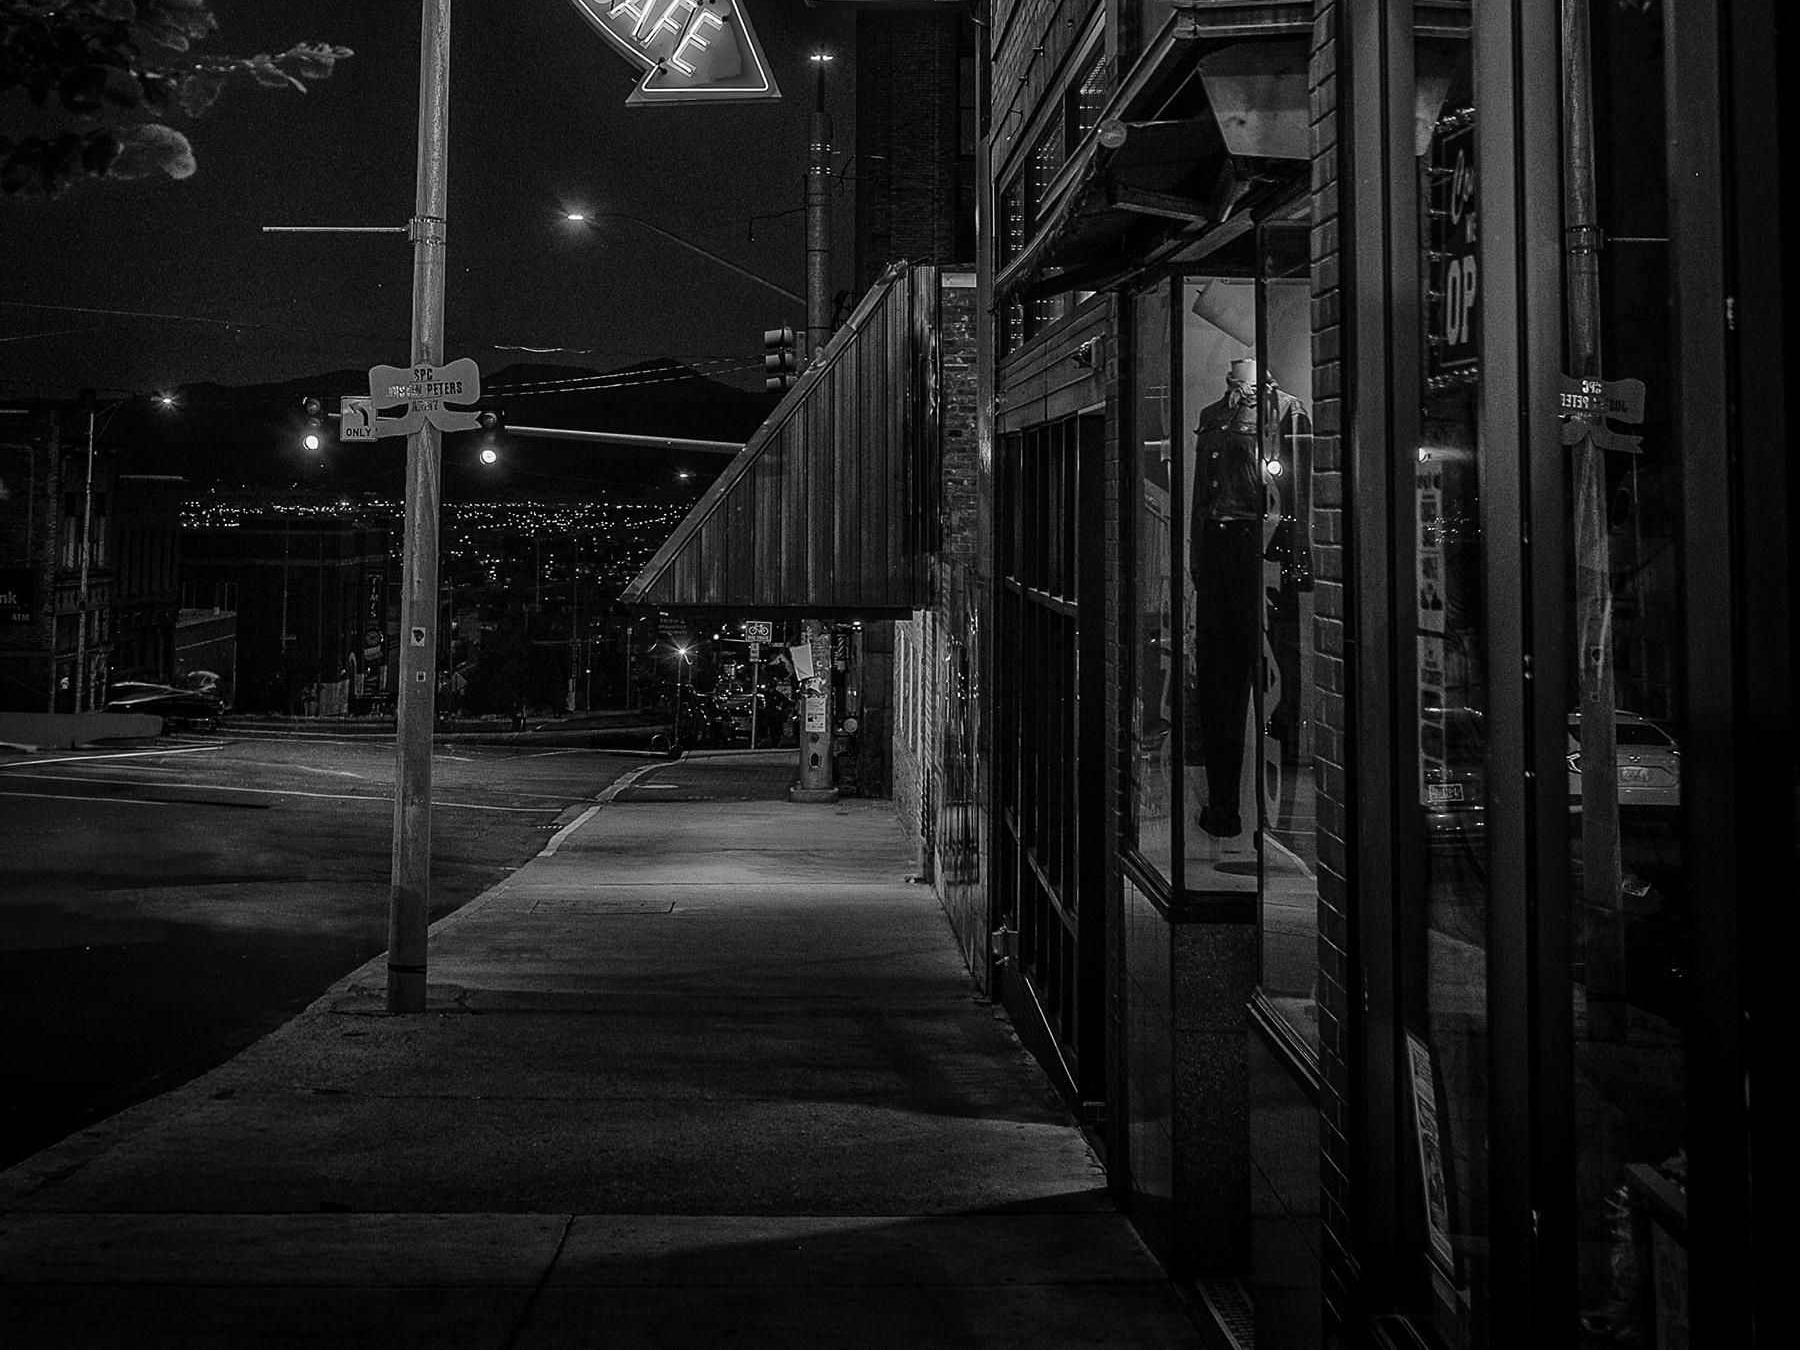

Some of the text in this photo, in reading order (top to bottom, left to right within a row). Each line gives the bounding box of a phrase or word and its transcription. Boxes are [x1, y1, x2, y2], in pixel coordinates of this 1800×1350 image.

[413, 368, 433, 382] SPC
[427, 381, 463, 396] PETERS
[346, 428, 372, 438] ONLY
